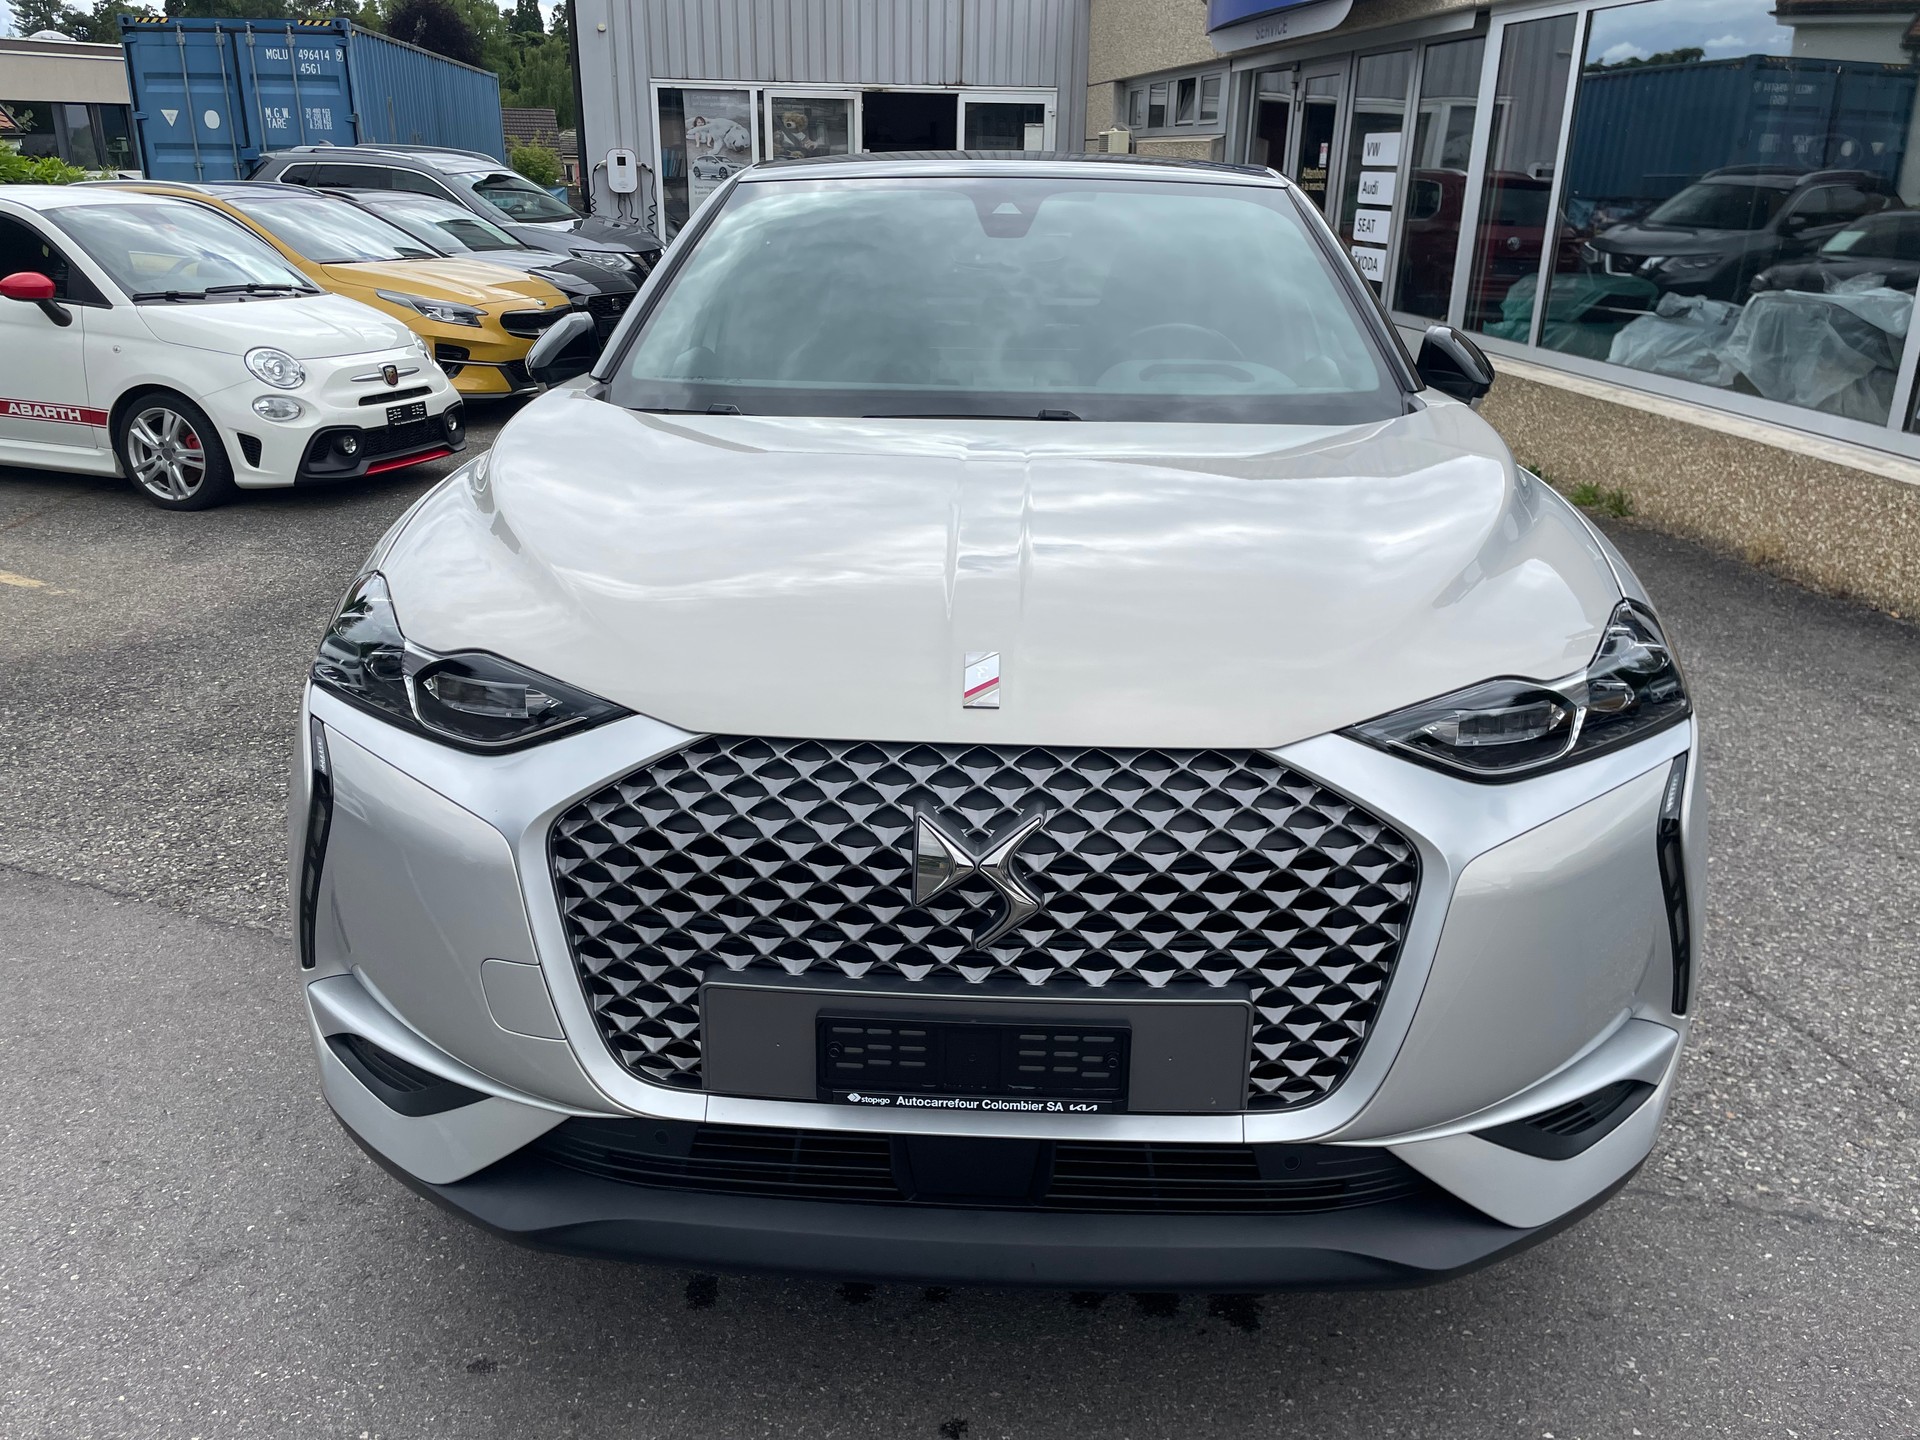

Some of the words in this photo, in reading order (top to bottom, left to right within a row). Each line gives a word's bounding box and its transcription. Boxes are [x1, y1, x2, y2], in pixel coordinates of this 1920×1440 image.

[1256, 19, 1288, 40] SERVICE
[265, 49, 289, 60] MGLU
[298, 49, 330, 61] 496414
[300, 63, 321, 74] 45G1
[265, 107, 291, 118] M.G.W.
[267, 118, 287, 129] TARE
[1366, 142, 1381, 157] VW
[1361, 181, 1379, 195] Audi
[1357, 218, 1376, 233] SEAT
[1354, 251, 1378, 272] KODA
[8, 403, 81, 421] ABARTH
[896, 1095, 980, 1109] Autocarrefour
[981, 1099, 1044, 1111] Colombier
[1046, 1101, 1064, 1112] SA
